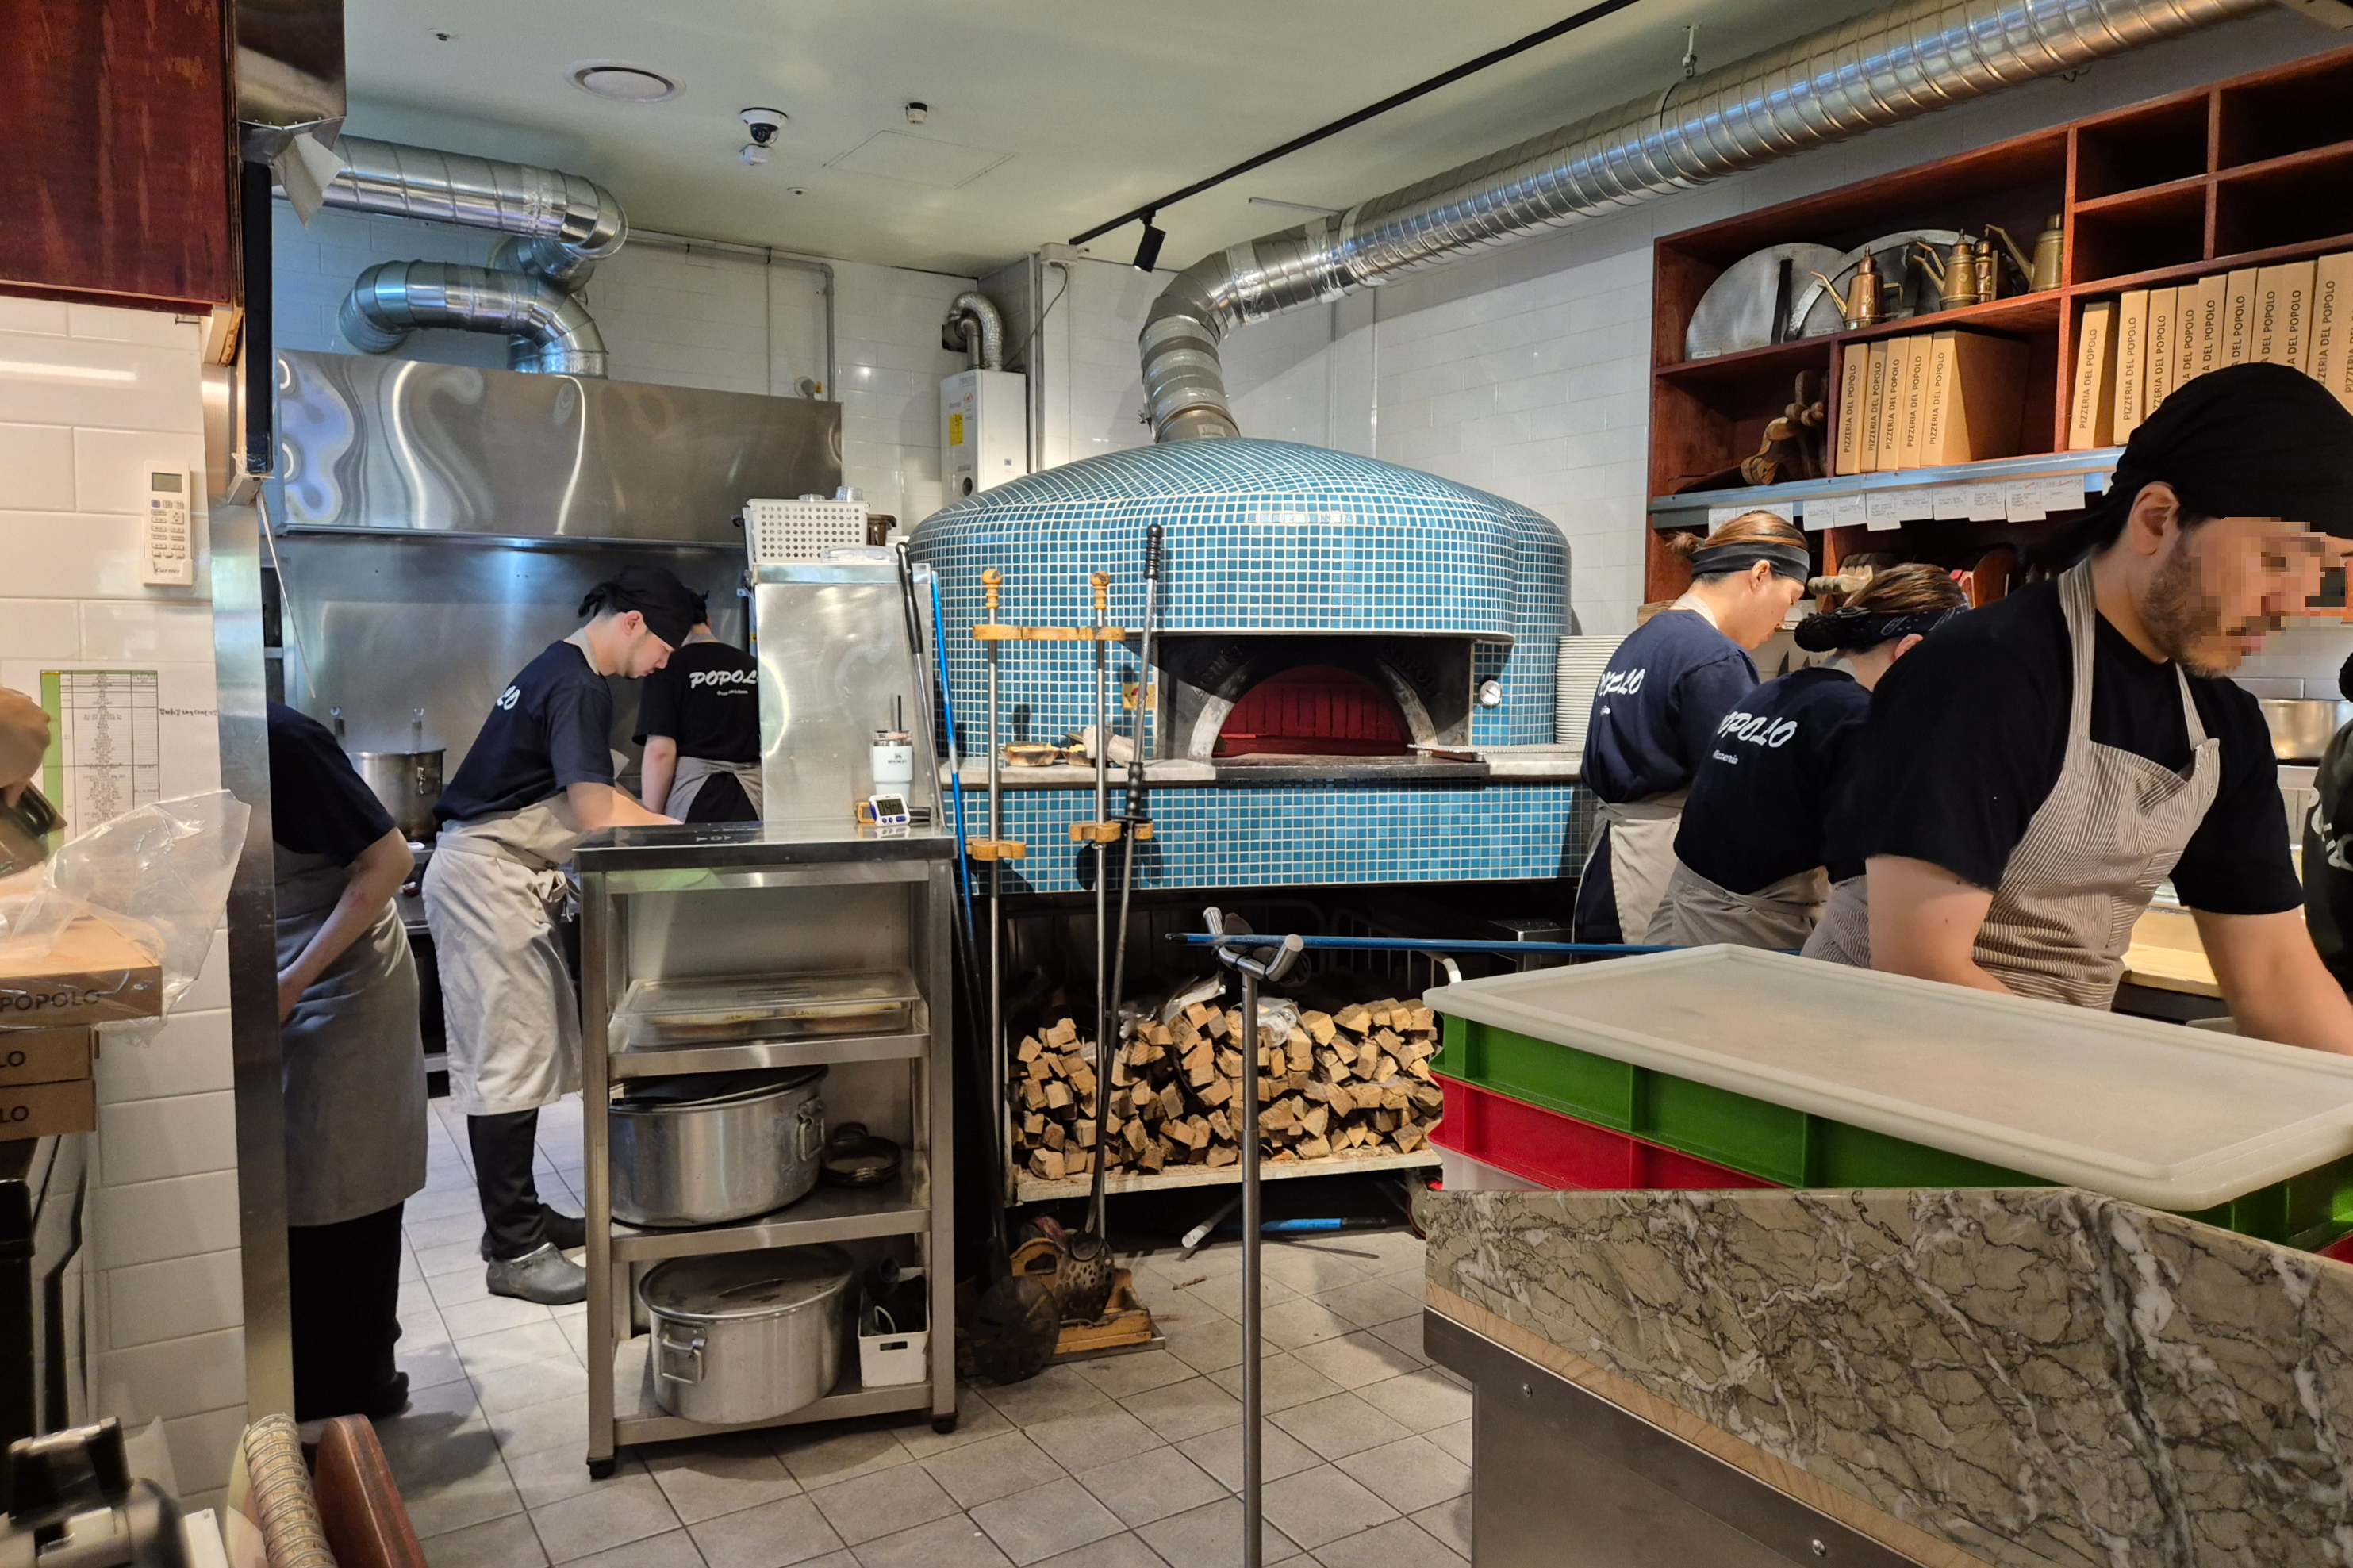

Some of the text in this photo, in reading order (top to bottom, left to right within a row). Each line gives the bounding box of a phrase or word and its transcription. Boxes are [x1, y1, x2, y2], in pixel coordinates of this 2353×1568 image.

[2184, 309, 2194, 349] POPOLO
[2204, 300, 2215, 341] POPOLO
[2233, 296, 2245, 336] POPOLO
[2264, 291, 2275, 332] POPOLO
[2290, 290, 2301, 332] POPOLO
[2203, 343, 2213, 362] DEL
[2232, 339, 2242, 358] DEL
[2263, 335, 2272, 354] DEL
[2288, 335, 2297, 355] DEL
[2317, 281, 2335, 385] ZZERIA DEL POPOLO
[1872, 362, 1882, 396] POPOLO
[2079, 328, 2098, 428] PIZZERIA DEL POPOLO
[2123, 317, 2136, 420] PIZZERIA DEL POPOLO
[2153, 315, 2166, 411] ZZERIA DEL POPOLO
[2183, 351, 2193, 370] DEL
[1844, 417, 1852, 453] PIZZERIA
[1848, 365, 1856, 397] POPOLO
[1885, 358, 1900, 449] PIZZERIA DEL POPOLO
[1907, 410, 1917, 447] PIZZERIA
[1913, 355, 1922, 390] POPOLO
[1929, 408, 1939, 444] PIZZERIA
[1935, 352, 1945, 387] POPOLO
[1868, 416, 1877, 450] PIZZERIA
[689, 670, 759, 688] POPOL
[1717, 711, 1798, 748] OPOLO
[0, 989, 101, 1013] POPOLO
